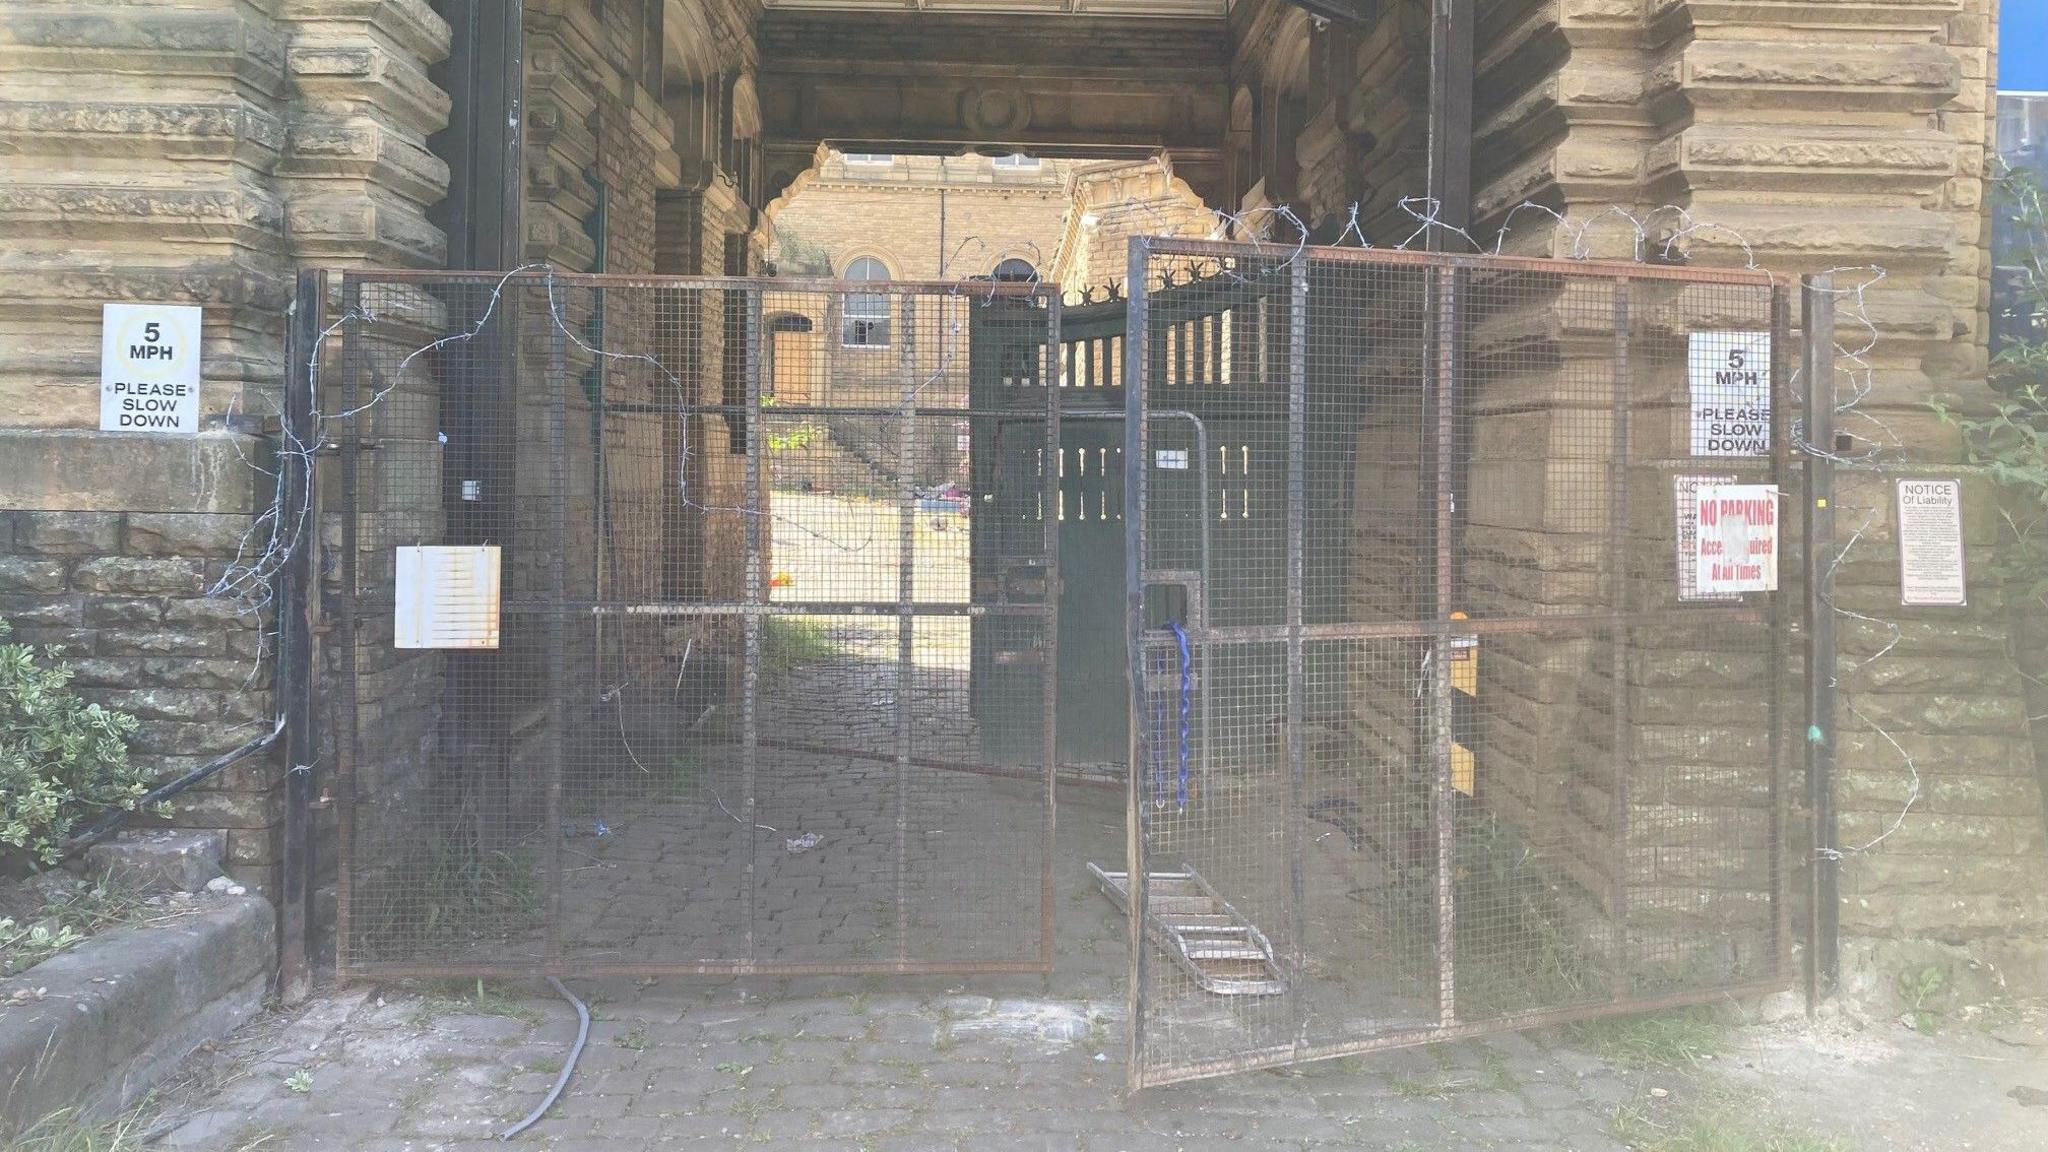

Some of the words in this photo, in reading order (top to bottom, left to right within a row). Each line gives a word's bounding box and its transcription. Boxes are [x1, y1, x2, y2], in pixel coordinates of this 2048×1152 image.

[144, 322, 160, 342] 5
[130, 345, 173, 360] MPH
[1728, 349, 1744, 368] 5
[1715, 371, 1757, 385] MPH
[114, 382, 187, 396] PLEASE
[122, 398, 177, 412] SLOW
[120, 414, 180, 428] DOWN
[1702, 408, 1771, 420] PLEASE
[1711, 424, 1763, 436] SLOW
[1708, 439, 1766, 451] DOWN
[1905, 485, 1952, 495] NOTICE
[1903, 495, 1914, 505] Of
[1917, 495, 1952, 506] Liability
[1700, 499, 1717, 526] NO
[1723, 564, 1734, 580] All
[1736, 563, 1762, 581] Times
